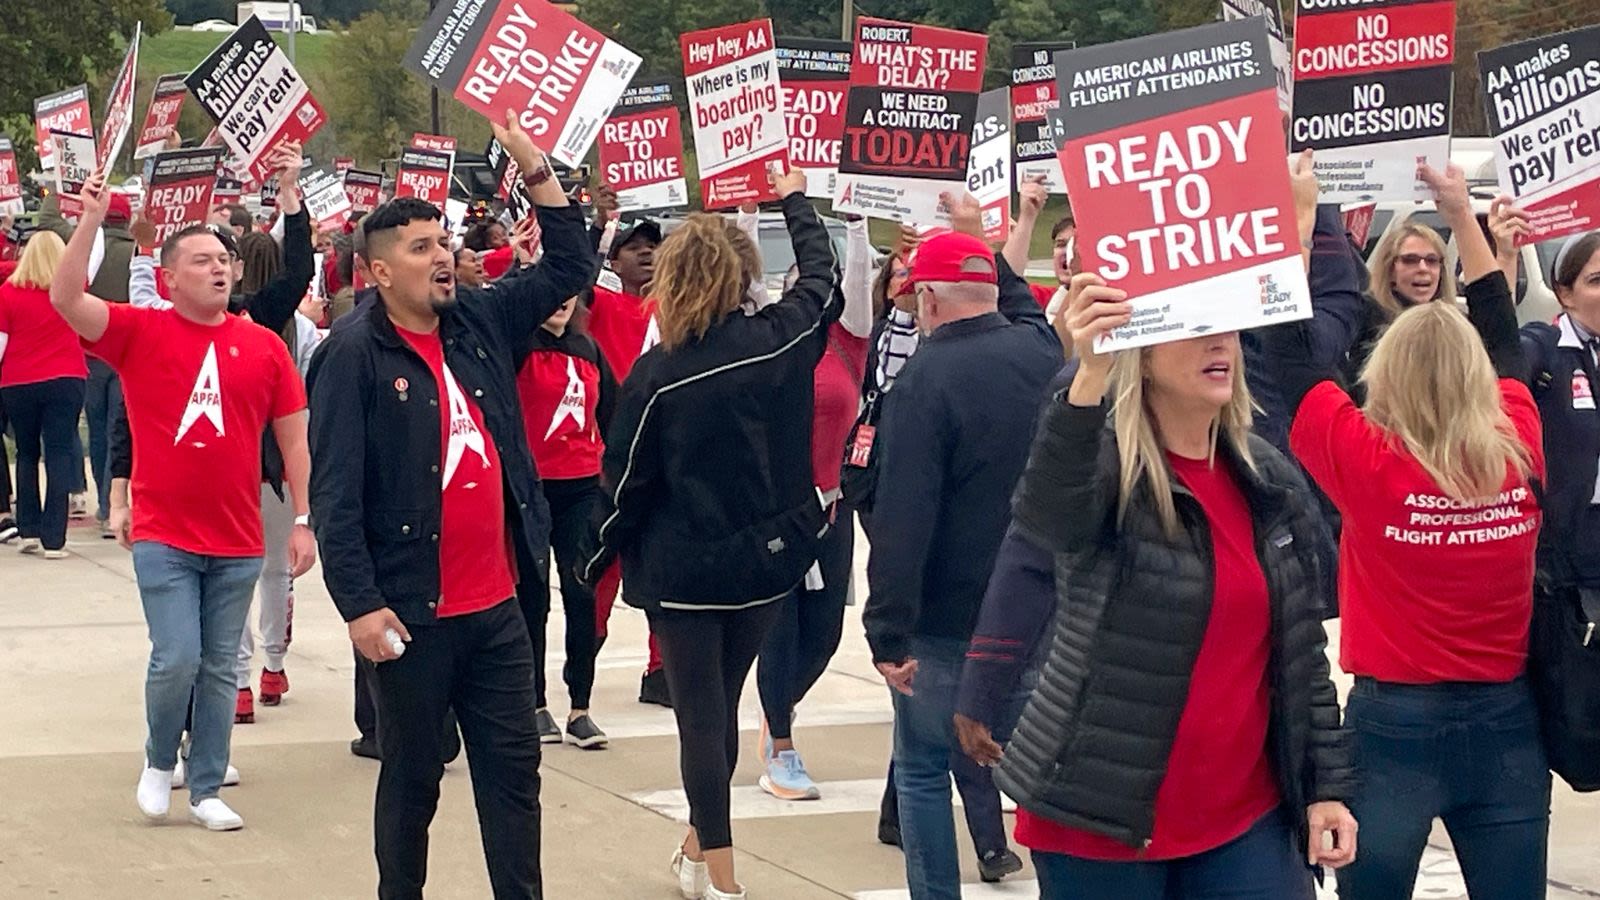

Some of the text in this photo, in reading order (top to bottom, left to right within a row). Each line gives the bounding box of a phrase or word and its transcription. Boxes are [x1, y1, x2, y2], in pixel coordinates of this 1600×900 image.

[862, 27, 910, 44] ROBERT,
[1357, 14, 1388, 40] NO
[421, 16, 459, 70] AMERICAN
[464, 3, 538, 105] READY
[688, 27, 767, 65] Hey hey, AA
[860, 43, 977, 71] WHAT'S THE
[1297, 34, 1448, 72] CONCESSIONS
[196, 41, 243, 102] AA makes
[429, 41, 457, 79] FLIGHT
[506, 49, 549, 91] TO
[1034, 50, 1048, 65] NO
[1073, 41, 1253, 88] AMERICAN AIRLINES
[1487, 43, 1570, 93] AA makes
[207, 39, 274, 118] billions.
[520, 30, 599, 136] STRIKE
[692, 60, 770, 97] Where is my
[878, 65, 950, 90] DELAY?
[1013, 64, 1056, 83] CONCESSI
[1069, 60, 1261, 107] FLIGHT ATTENDANTS:
[224, 77, 271, 135] We can't
[696, 83, 777, 129] boarding
[782, 88, 843, 116] EADY
[881, 92, 948, 112] WE NEED
[1036, 86, 1050, 101] NO
[1353, 83, 1385, 109] NO
[40, 107, 82, 130] READY
[236, 109, 267, 154] pay
[263, 67, 296, 114] rent
[862, 108, 962, 130] A CONTRACT
[1294, 103, 1445, 142] CONCESSIONS
[604, 117, 669, 144] READY
[723, 113, 763, 158] pay?
[785, 113, 817, 138] TO
[1501, 108, 1584, 160] We can't
[624, 140, 653, 161] TO
[790, 137, 842, 165] RIKE
[846, 127, 969, 169] TODAY!
[1084, 116, 1252, 188] READY
[402, 172, 443, 190] READY
[607, 157, 679, 184] STRIKE
[968, 157, 1004, 192] ent
[1508, 146, 1556, 197] pay
[151, 185, 207, 207] READY
[413, 185, 429, 201] TO
[1139, 173, 1211, 224] TO
[164, 205, 186, 223] TO
[1097, 207, 1285, 280] STRIKE
[1261, 291, 1291, 304] READY
[191, 391, 220, 406] APFA
[562, 396, 584, 407] APFA
[451, 418, 477, 436] APFA
[1410, 505, 1523, 526] PROFESSIONAL
[1385, 525, 1443, 545] FLIGHT
